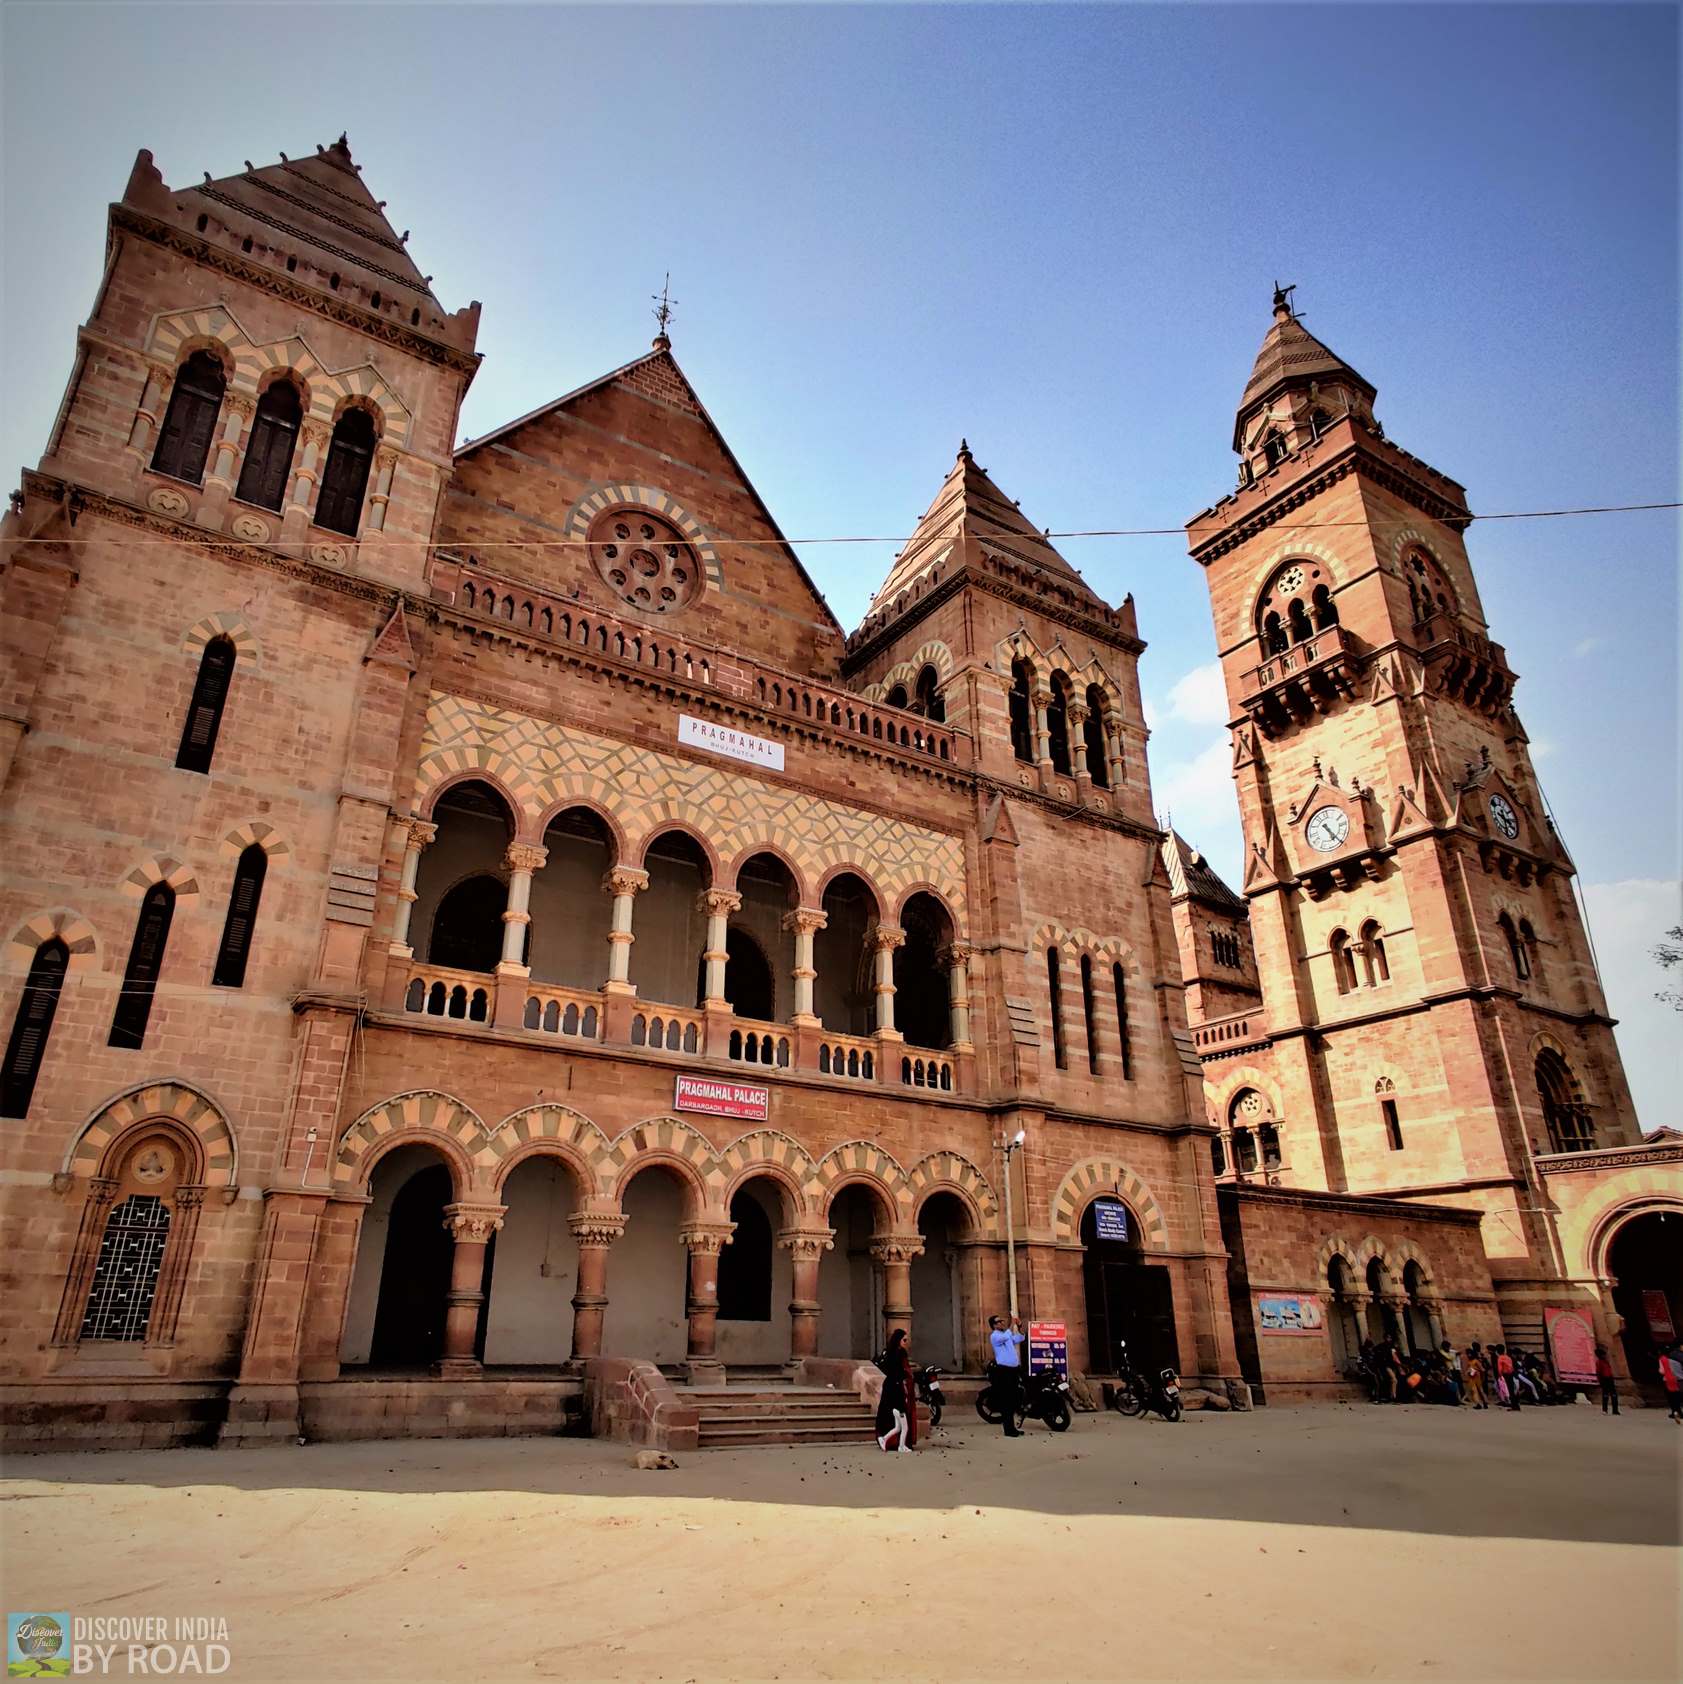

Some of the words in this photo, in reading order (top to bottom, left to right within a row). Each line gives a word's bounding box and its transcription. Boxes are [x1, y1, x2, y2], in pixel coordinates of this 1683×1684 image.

[692, 722, 773, 755] PRAGMAHAL
[679, 1080, 733, 1101] PRAGMAHAL
[734, 1089, 766, 1106] PALACE
